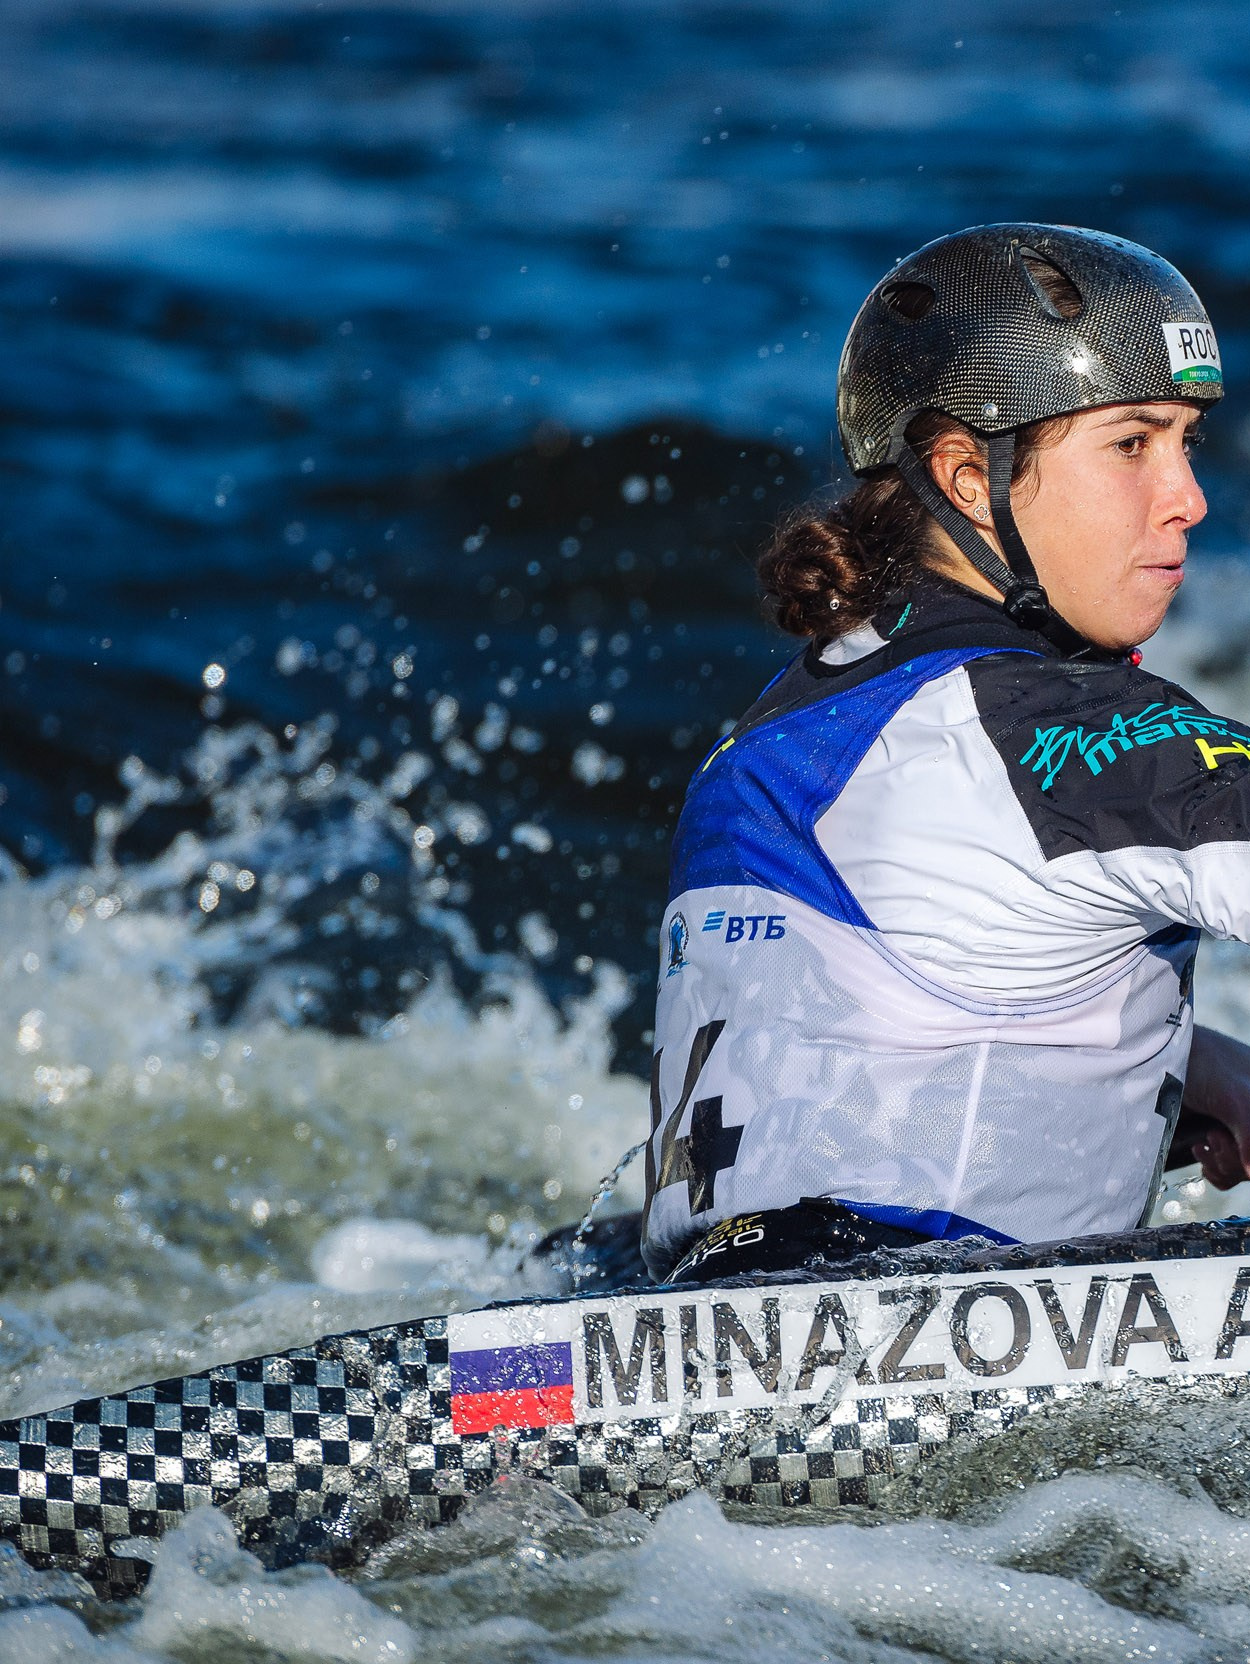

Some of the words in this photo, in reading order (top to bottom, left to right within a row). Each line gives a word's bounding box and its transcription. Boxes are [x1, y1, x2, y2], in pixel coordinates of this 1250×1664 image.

[1179, 328, 1217, 360] ROC
[725, 915, 787, 944] ВТБ
[582, 1272, 1191, 1409] MINAZOVA
